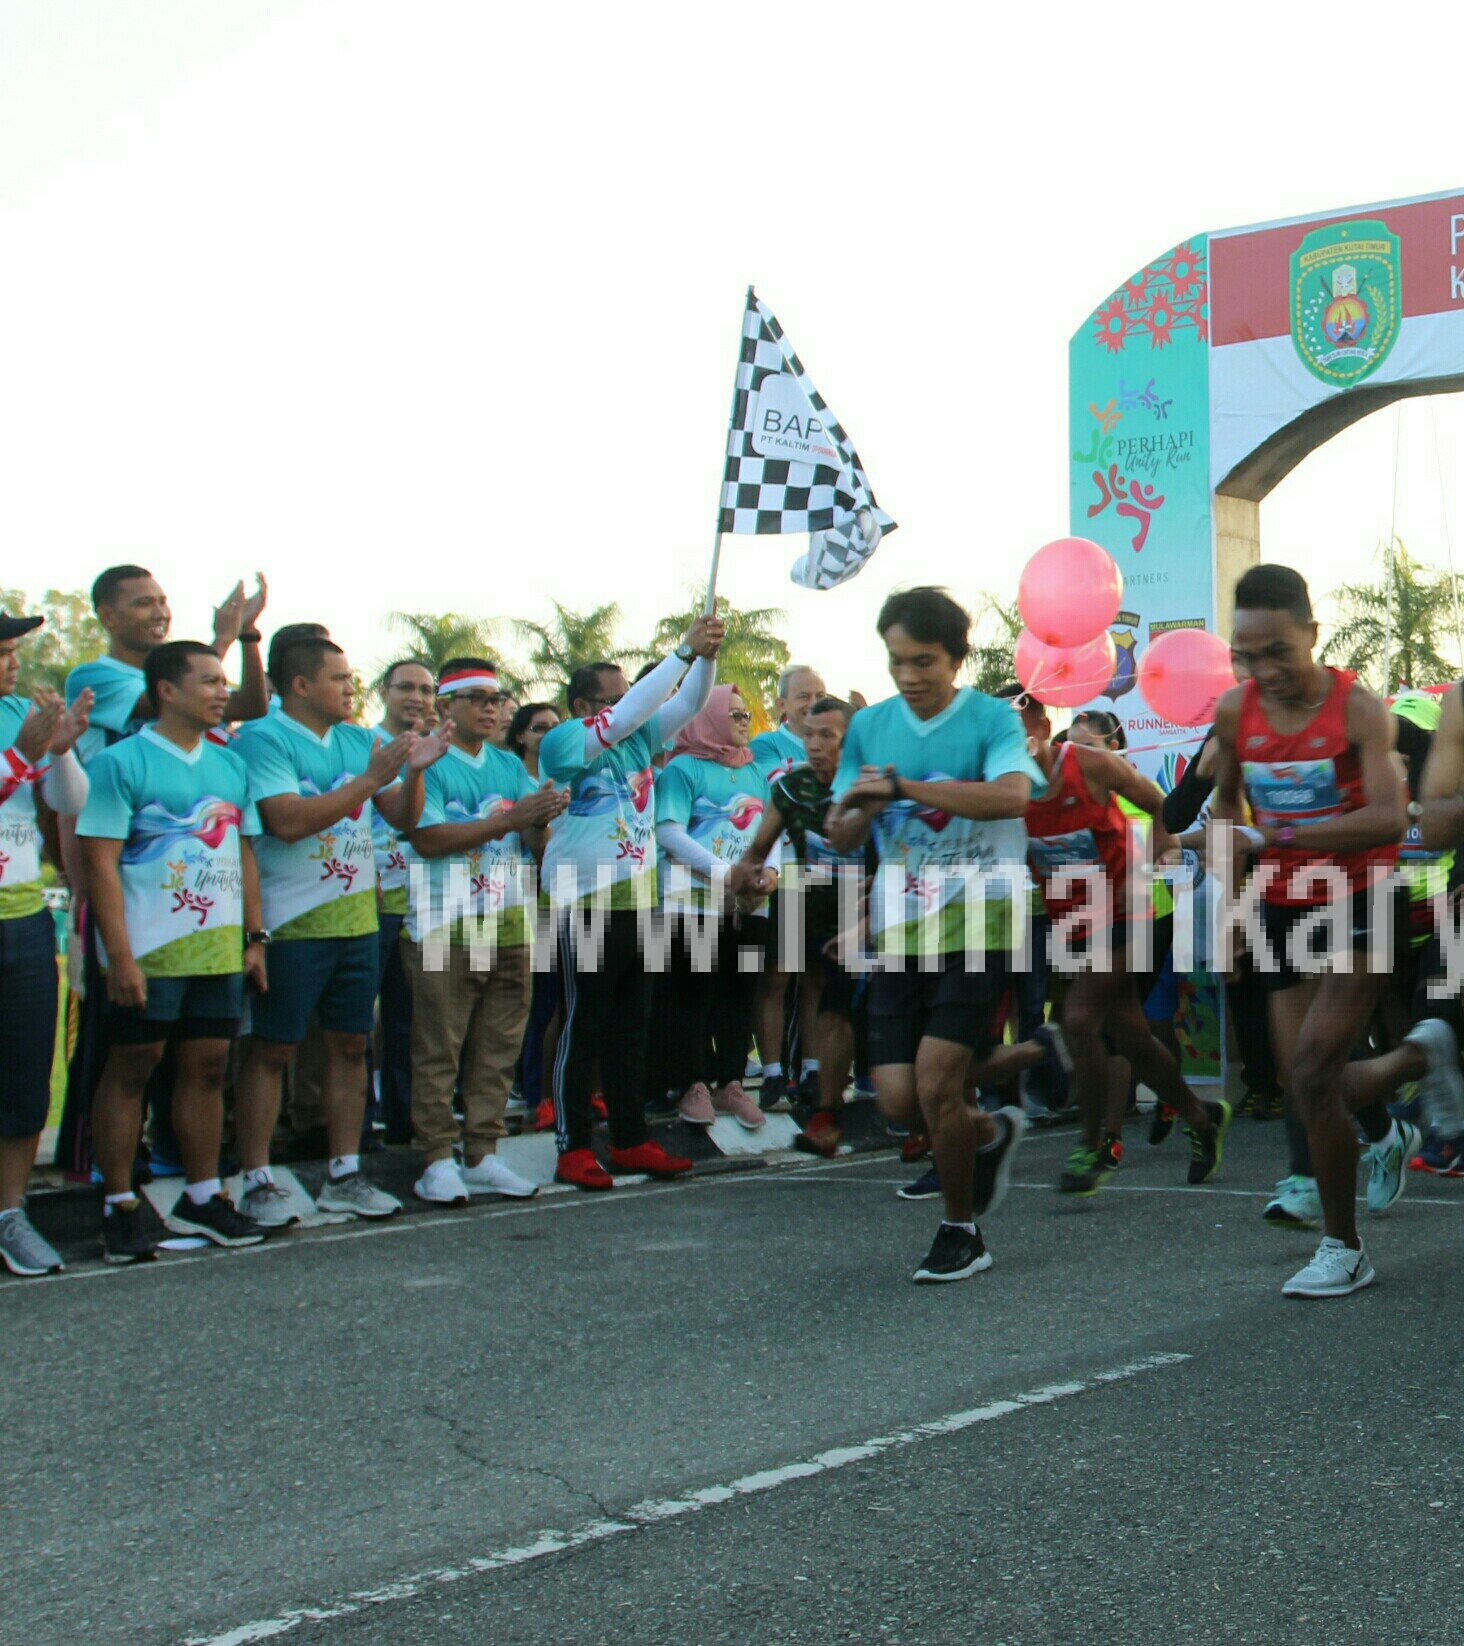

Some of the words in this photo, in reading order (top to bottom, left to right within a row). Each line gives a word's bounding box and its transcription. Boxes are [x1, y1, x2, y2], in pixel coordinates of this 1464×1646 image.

[763, 409, 832, 446] BAP
[761, 435, 774, 443] PT
[775, 437, 809, 451] KALTIM
[1117, 430, 1194, 456] PERHAPI
[1125, 448, 1161, 478] Unity
[1166, 446, 1191, 469] Run
[1123, 571, 1169, 586] ARTNERS
